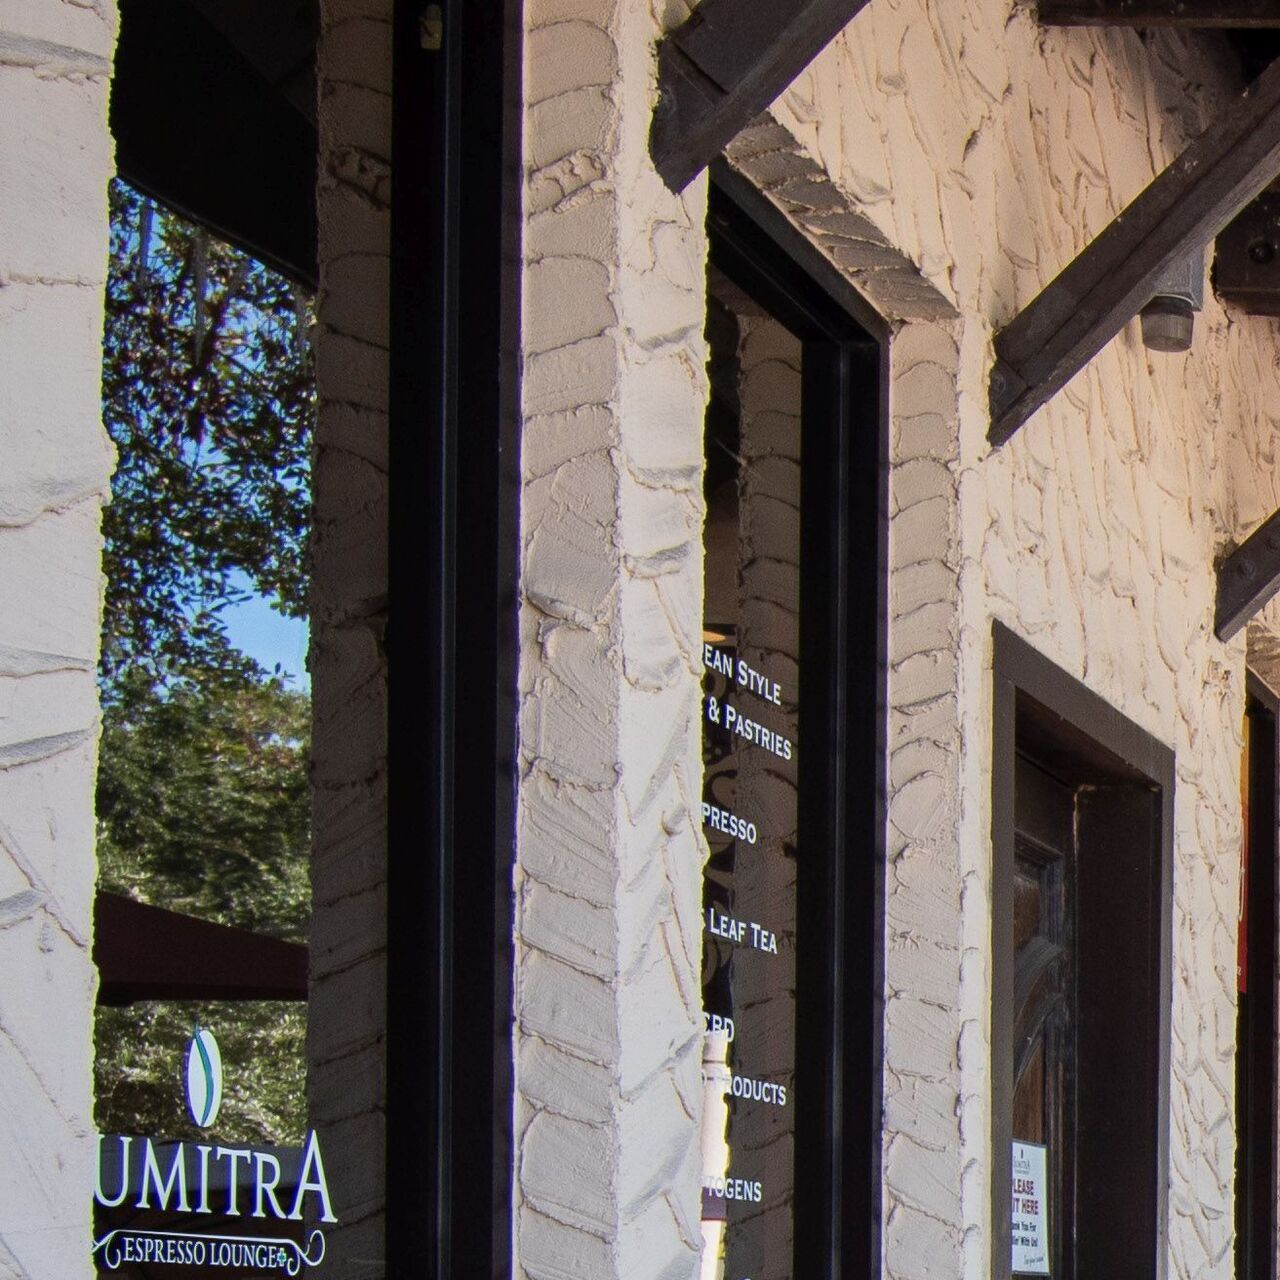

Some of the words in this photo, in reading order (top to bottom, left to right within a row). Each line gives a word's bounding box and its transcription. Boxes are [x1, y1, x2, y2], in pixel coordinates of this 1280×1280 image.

[736, 659, 782, 706] STYLE
[708, 696, 720, 725] &
[725, 703, 792, 761] PASTRIES
[709, 907, 747, 943] LEAF
[750, 922, 778, 955] TEA
[123, 1237, 206, 1266] ESPRESSO
[210, 1242, 277, 1268] LOUNGE
